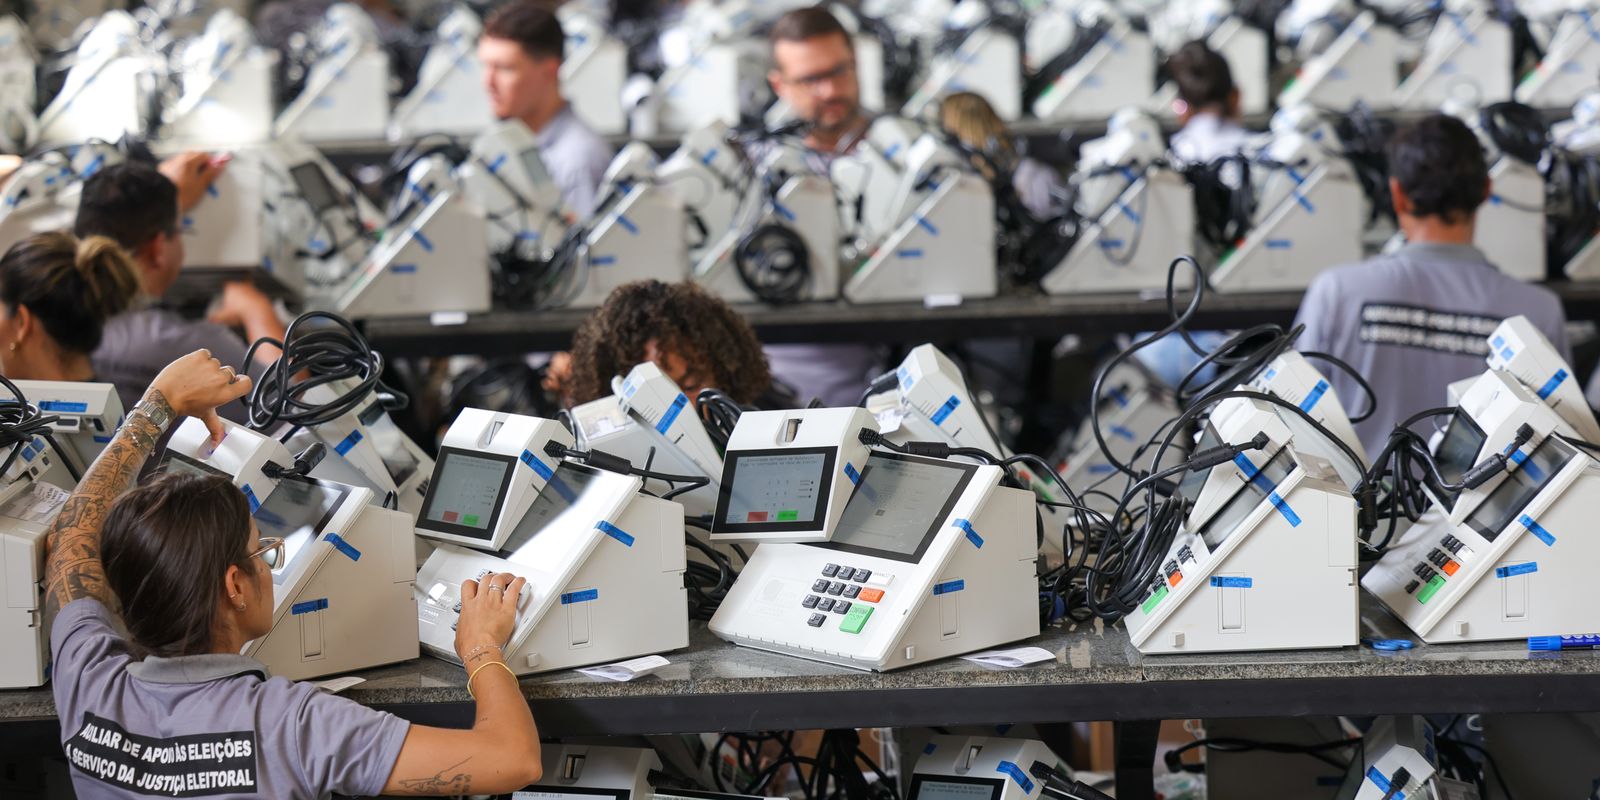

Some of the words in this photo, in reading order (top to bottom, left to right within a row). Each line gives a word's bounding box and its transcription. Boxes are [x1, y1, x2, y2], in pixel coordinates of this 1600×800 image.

[79, 722, 123, 750] AULIAR
[122, 738, 142, 758] DE
[174, 742, 187, 763] ÀS
[188, 738, 252, 763] ELEIÇÕES
[72, 747, 117, 779] SERVIÇO
[116, 763, 136, 784] DA
[136, 772, 186, 796] JUSTIÇA
[186, 768, 254, 791] ELEITORAL
